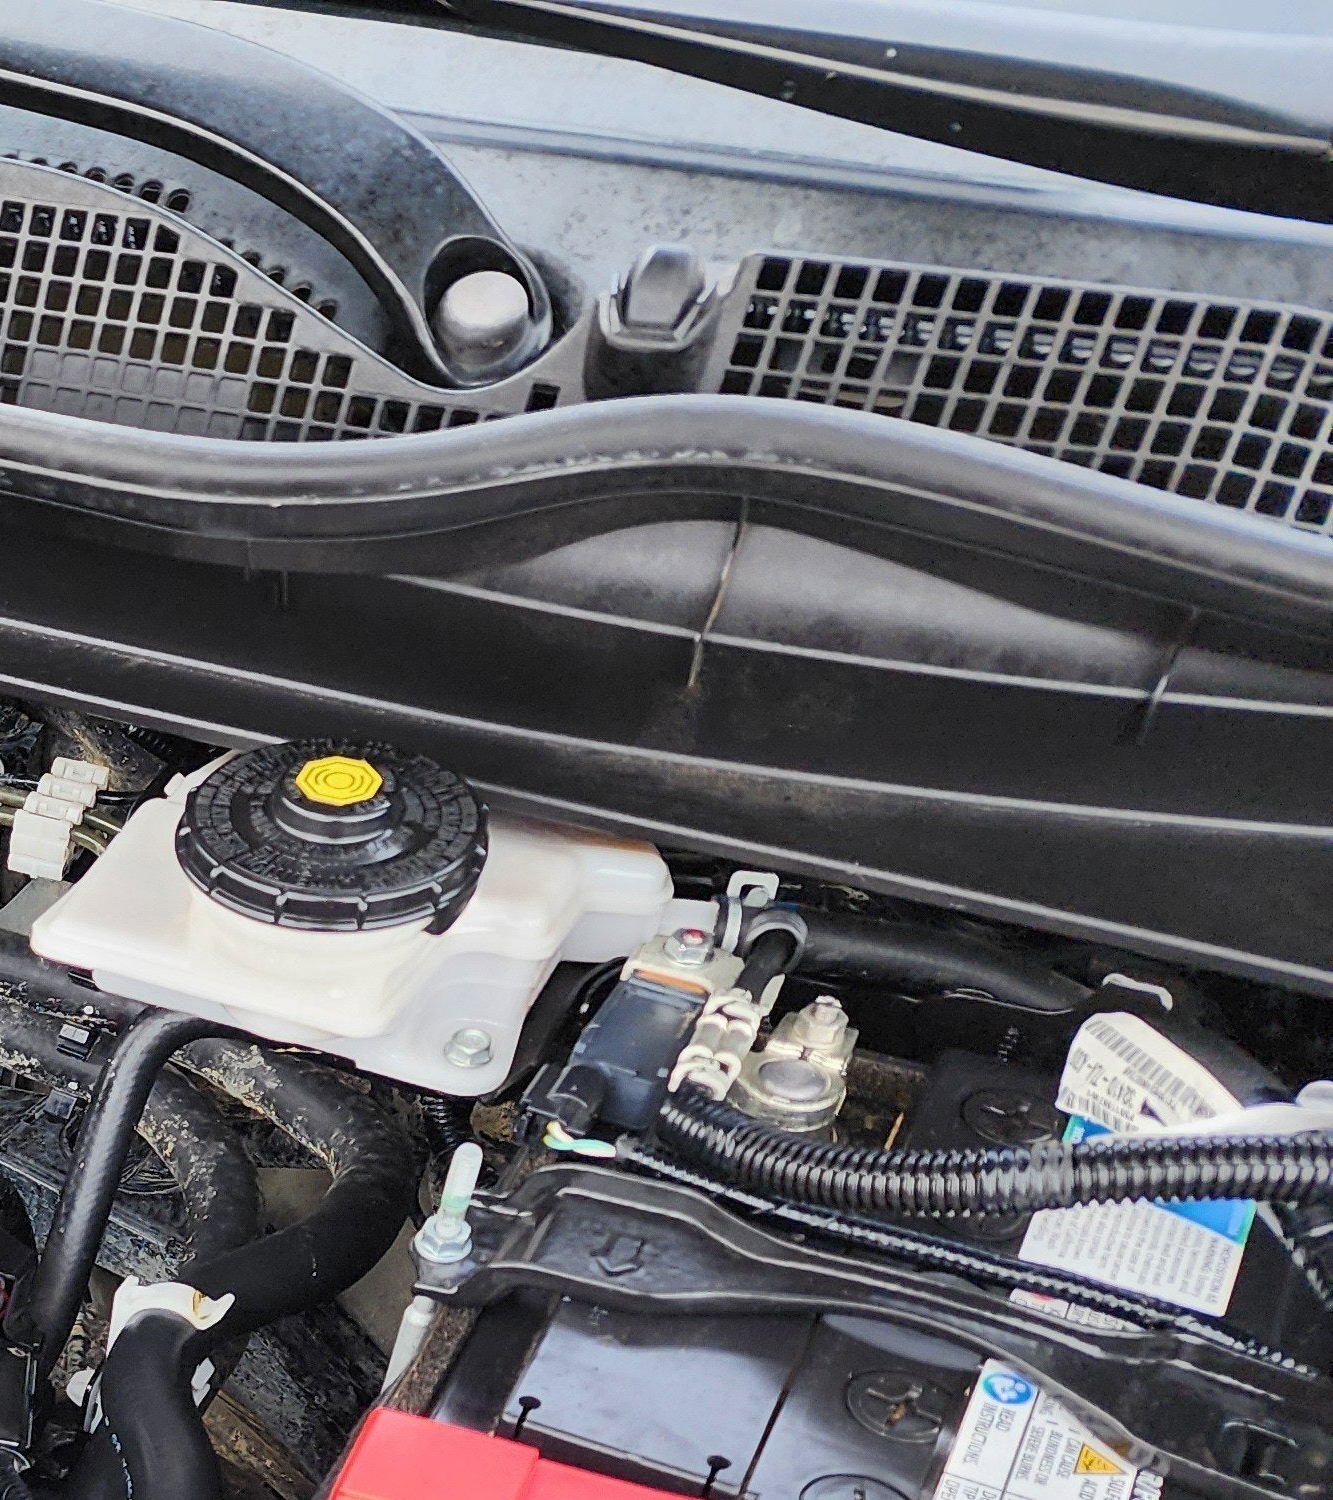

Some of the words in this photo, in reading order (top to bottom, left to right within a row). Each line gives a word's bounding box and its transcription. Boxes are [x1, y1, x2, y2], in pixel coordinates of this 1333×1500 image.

[996, 1407, 1015, 1432] READ
[1055, 1454, 1074, 1480] CAUSE
[961, 1484, 978, 1500] TIP
